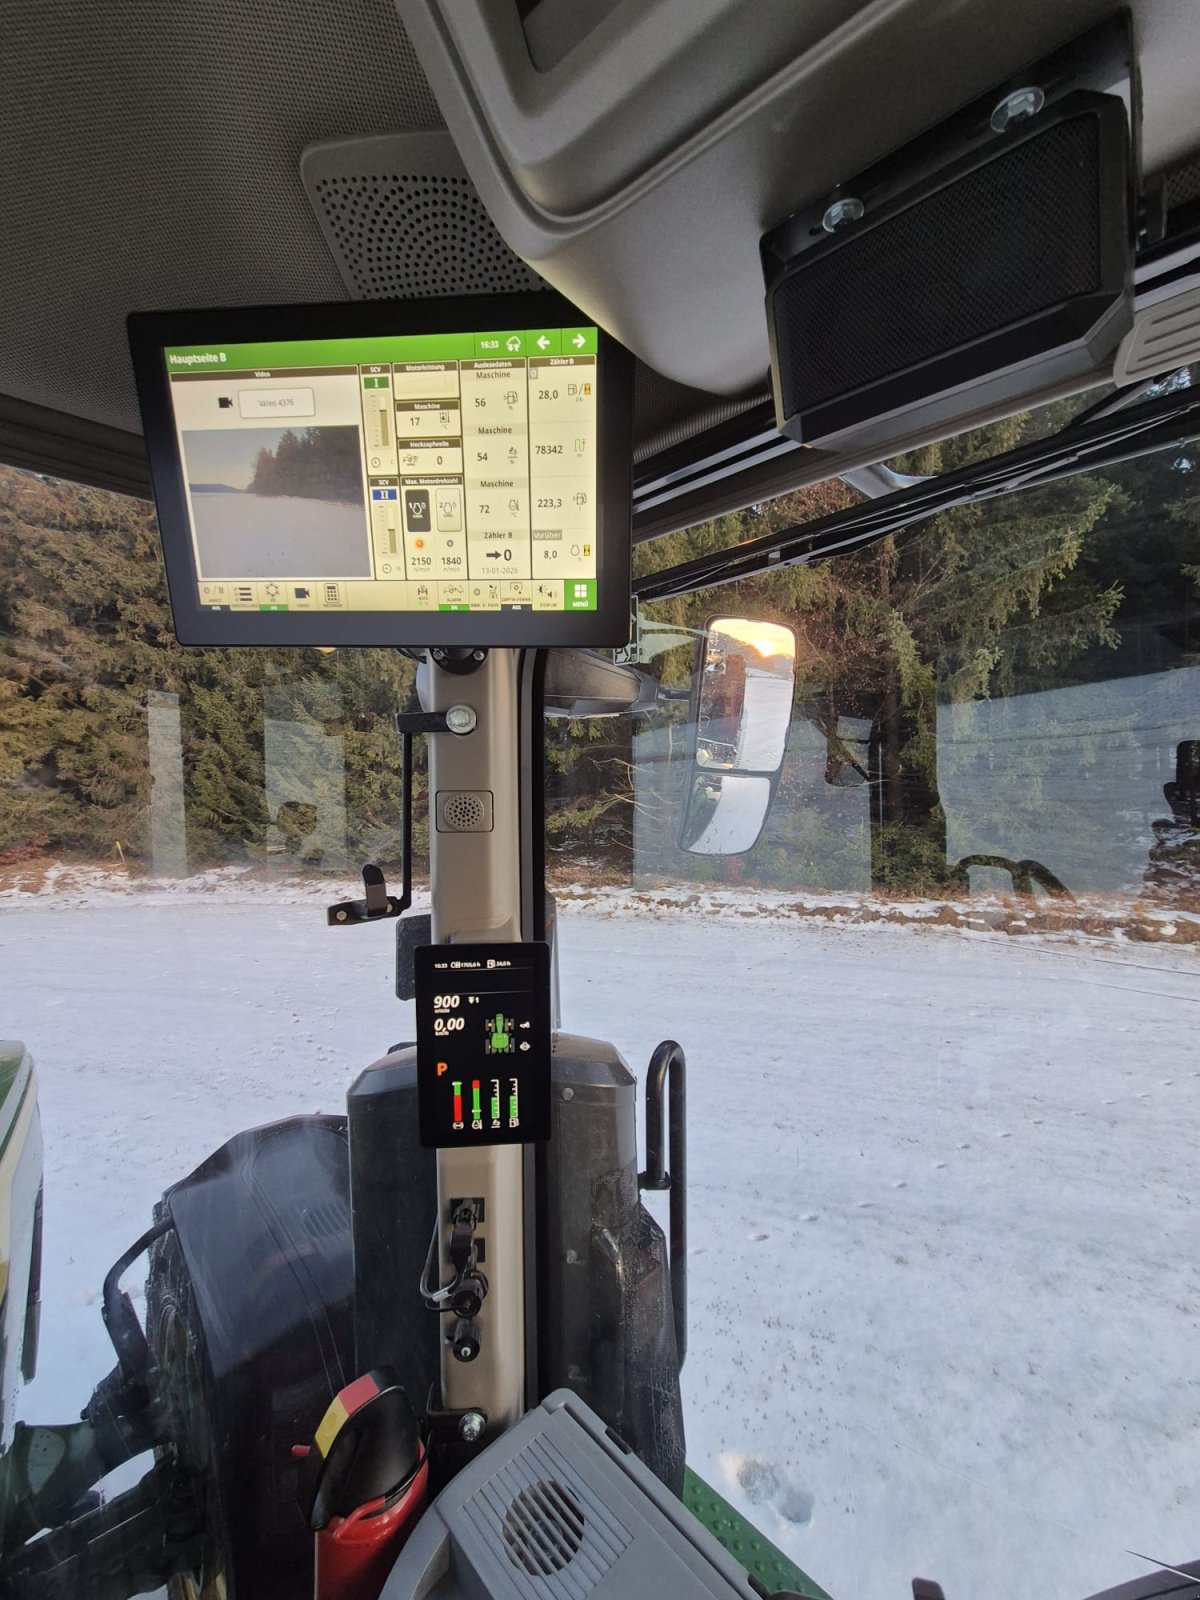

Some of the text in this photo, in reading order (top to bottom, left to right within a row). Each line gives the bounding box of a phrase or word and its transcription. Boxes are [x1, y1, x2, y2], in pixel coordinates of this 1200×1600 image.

[169, 352, 227, 366] Hauptseite B
[255, 371, 271, 379] Video
[476, 371, 511, 379] Maschine
[538, 389, 559, 401] 28,0
[475, 398, 486, 408] 56
[410, 417, 421, 427] 17
[478, 427, 513, 435] Maschine
[535, 445, 563, 455] 78342
[437, 455, 443, 465] 0
[477, 453, 488, 462] 54
[480, 479, 514, 488] Maschine
[537, 498, 562, 509] 223,3
[479, 504, 490, 514] 72
[484, 531, 506, 540] Zähler
[503, 549, 512, 562] 0
[543, 550, 558, 560] 8,0
[411, 557, 432, 566] 2150
[441, 557, 462, 566] 1840
[481, 566, 518, 575] 13-01-2026
[433, 995, 460, 1009] 900
[434, 1017, 465, 1033] 0,00
[436, 1062, 448, 1076] P
